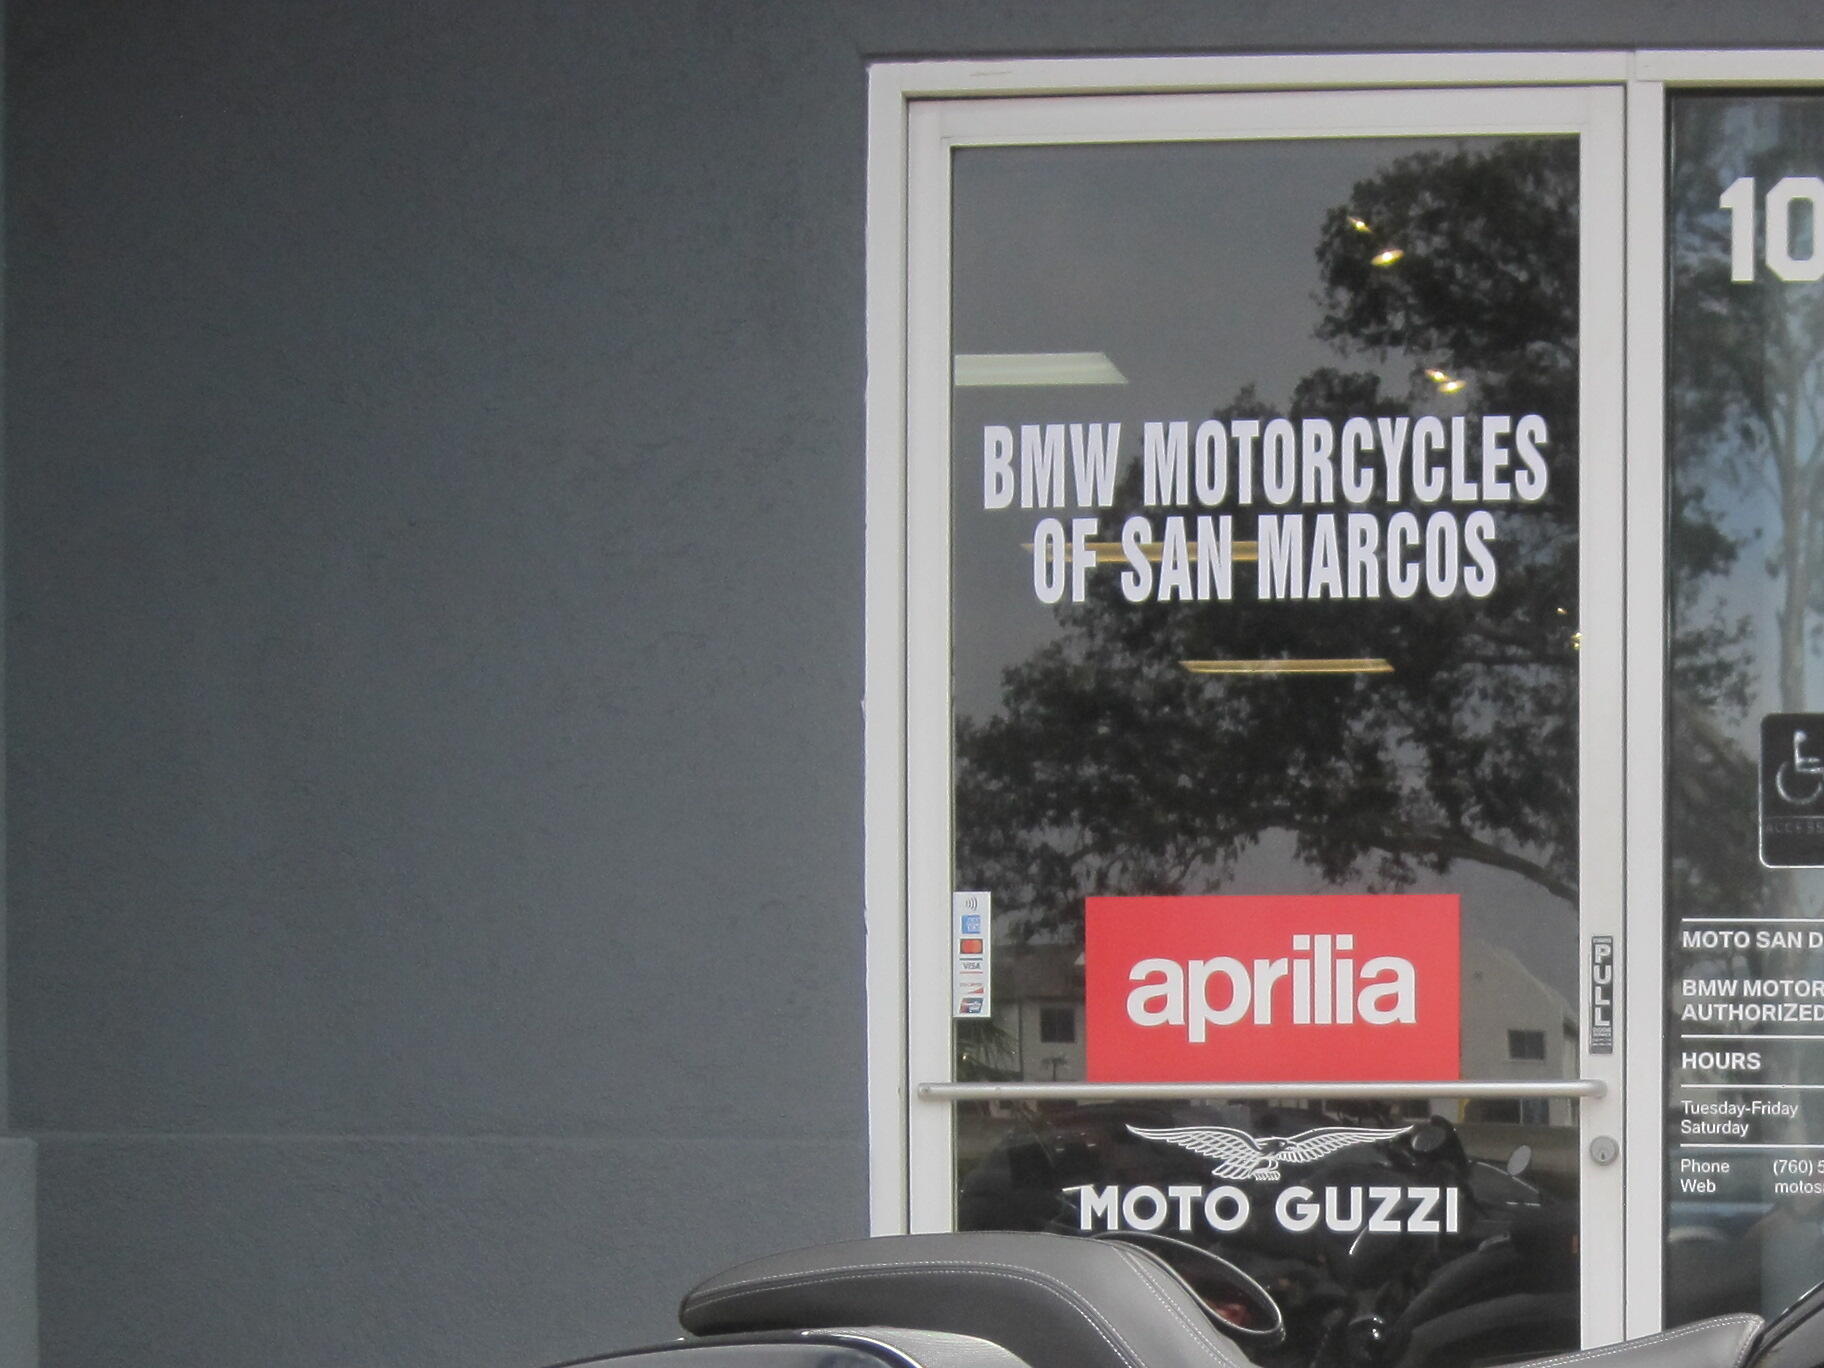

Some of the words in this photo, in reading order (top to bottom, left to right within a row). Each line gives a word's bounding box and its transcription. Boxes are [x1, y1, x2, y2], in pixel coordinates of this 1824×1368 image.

[983, 423, 1121, 509] BMW
[1143, 414, 1549, 506] MOTORCYCLES
[1033, 517, 1098, 603] OF
[1121, 514, 1233, 601] SAN
[1257, 510, 1498, 601] MARCOS
[1682, 931, 1750, 949] MOTO
[1756, 931, 1802, 949] SAN
[1126, 934, 1417, 1043] aprilia
[1593, 943, 1612, 1027] PULL
[1682, 979, 1738, 997] BMW
[1681, 1052, 1762, 1070] HOURS
[1681, 1100, 1799, 1118] Tuesday-Friday
[1680, 1119, 1749, 1137] Saturday
[1680, 1159, 1730, 1174] Phone
[1773, 1159, 1814, 1177] (760)
[1680, 1179, 1717, 1193] Web
[1079, 1186, 1249, 1231] MOTO
[1275, 1186, 1458, 1233] GUZZI
